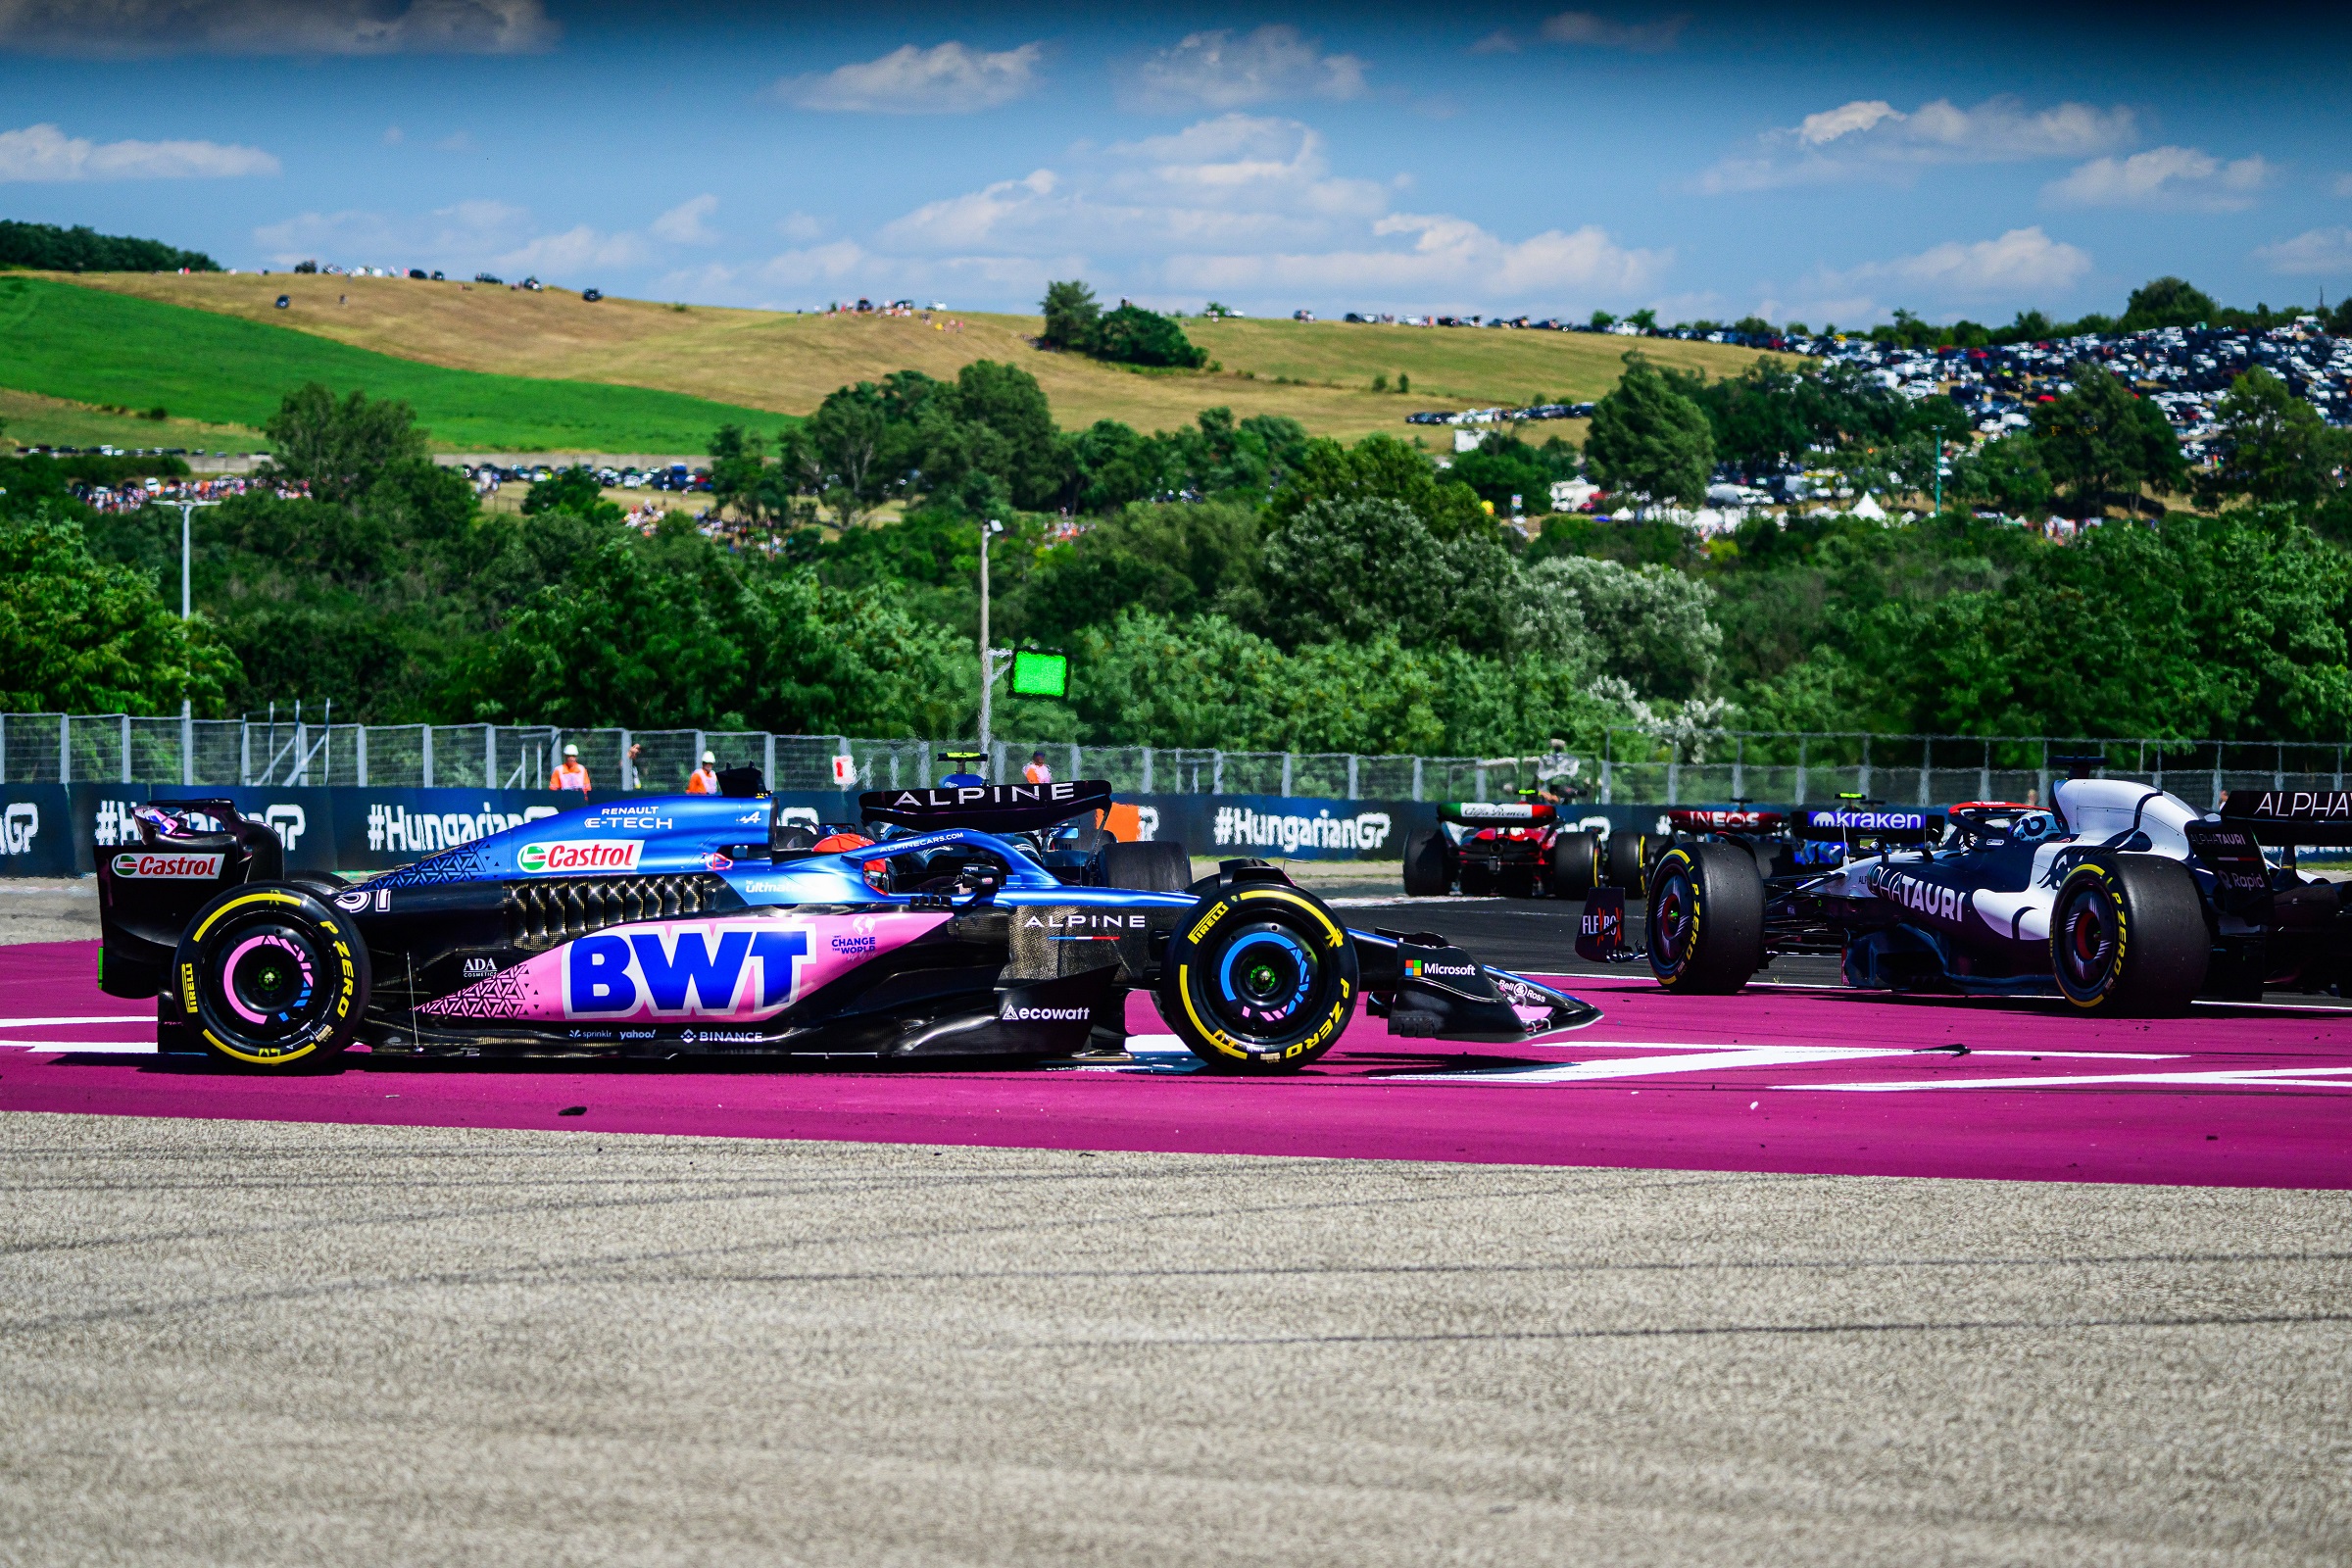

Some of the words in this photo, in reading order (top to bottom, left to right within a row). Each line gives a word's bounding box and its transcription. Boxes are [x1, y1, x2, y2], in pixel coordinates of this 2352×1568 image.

[893, 782, 1075, 807] ALPINE
[2254, 792, 2352, 817] ALPHA
[601, 806, 660, 816] RENAULT
[1690, 811, 1760, 828] INEOS
[1835, 811, 1921, 830] kraken
[584, 816, 673, 830] E-TECH
[1213, 807, 1392, 854] #HungarianGP
[879, 832, 964, 854] ALPINECARS.COM
[2190, 833, 2246, 846] ALPHATAURI
[138, 856, 217, 876] Castrol
[549, 844, 635, 868] Castrol
[1691, 883, 1700, 897] P
[2231, 872, 2266, 892] Rapid
[2111, 892, 2123, 905] P
[1023, 914, 1146, 928] ALPINE
[1187, 901, 1230, 945] PIRELLI
[1686, 901, 1700, 961] ZERO
[831, 937, 876, 948] CHANGE
[841, 945, 876, 955] WORLD
[2113, 910, 2127, 976] ZERO
[319, 920, 339, 935] P
[333, 940, 355, 1018] ZERO
[463, 957, 498, 971] ADA
[568, 930, 809, 1014] BWT
[1424, 962, 1476, 977] Microsoft
[181, 962, 199, 1013] PIRELLI
[1340, 977, 1350, 1000] P
[1499, 979, 1515, 992] Bell
[1527, 989, 1546, 1003] Ross
[1018, 1006, 1090, 1020] ecowatt
[582, 1030, 612, 1039] sprinklr
[619, 1029, 657, 1040] yahoo!
[699, 1031, 763, 1043] BINANCE
[1285, 1002, 1345, 1059] ZERO
